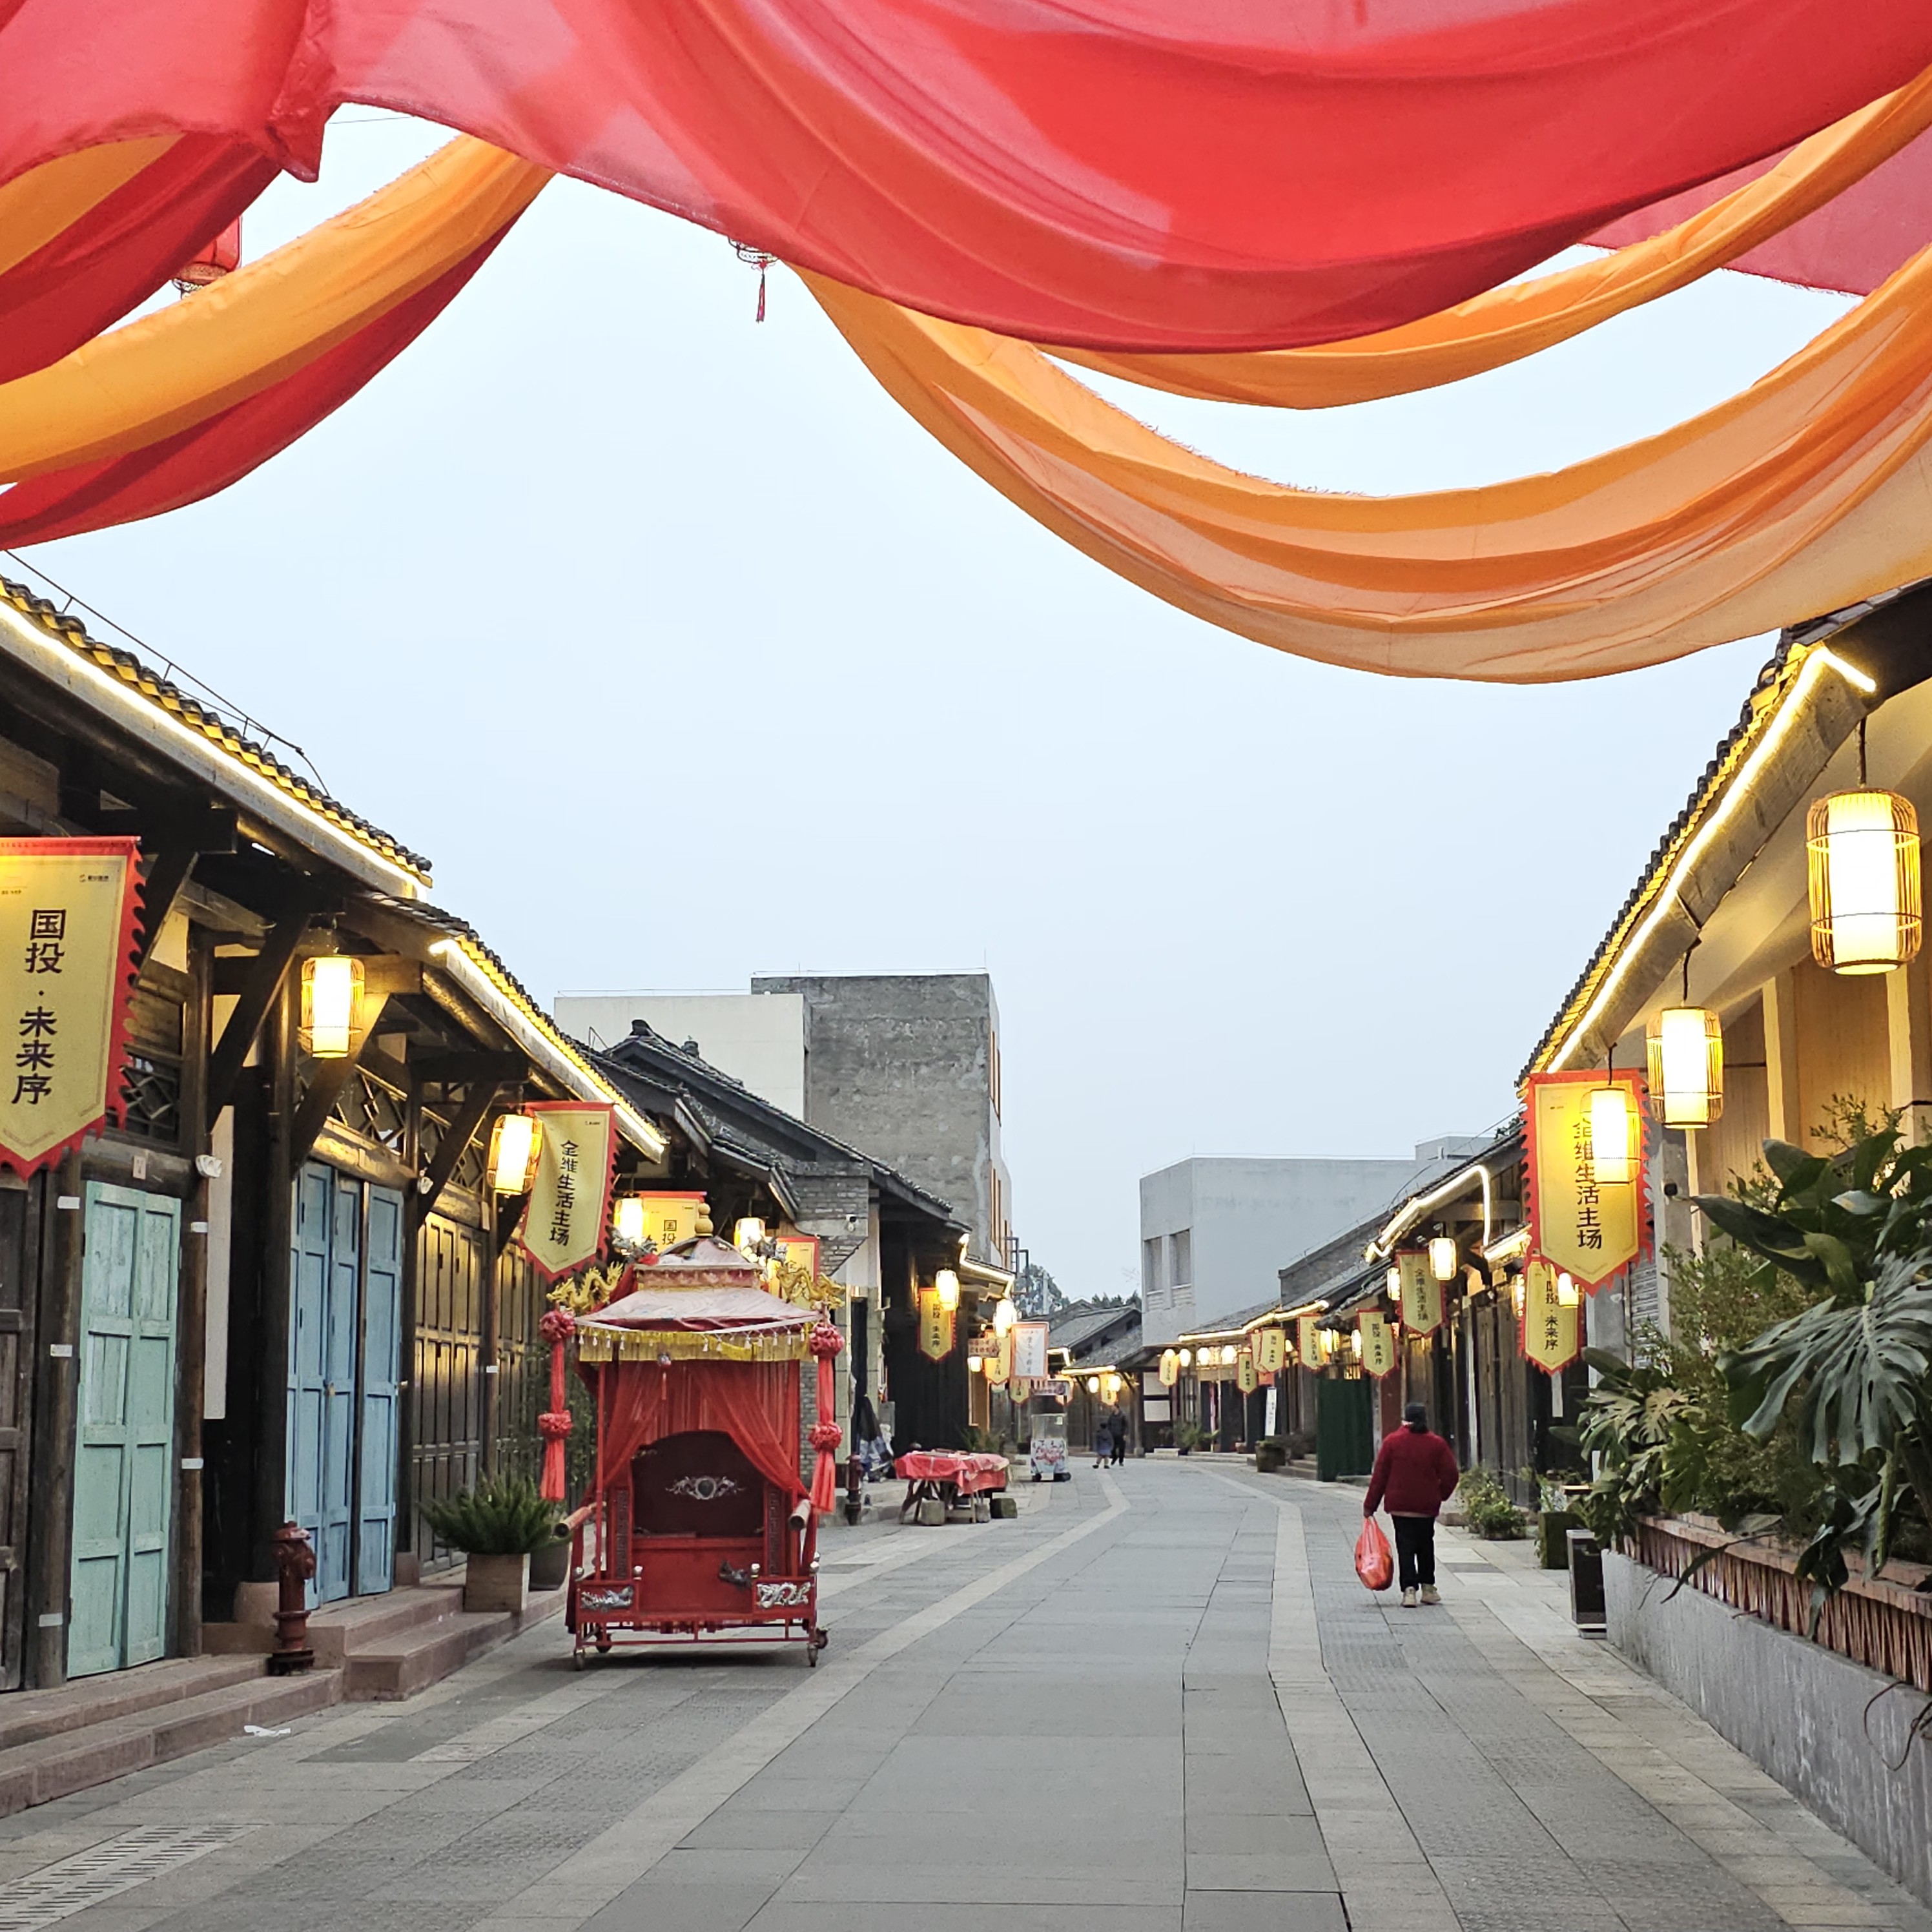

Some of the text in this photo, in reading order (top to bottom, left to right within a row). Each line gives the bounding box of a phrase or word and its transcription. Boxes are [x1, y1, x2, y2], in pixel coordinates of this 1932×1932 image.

[12, 909, 67, 1105] 国投·未来序
[549, 1139, 579, 1246] 全维生活主场
[662, 1220, 677, 1245] 国投
